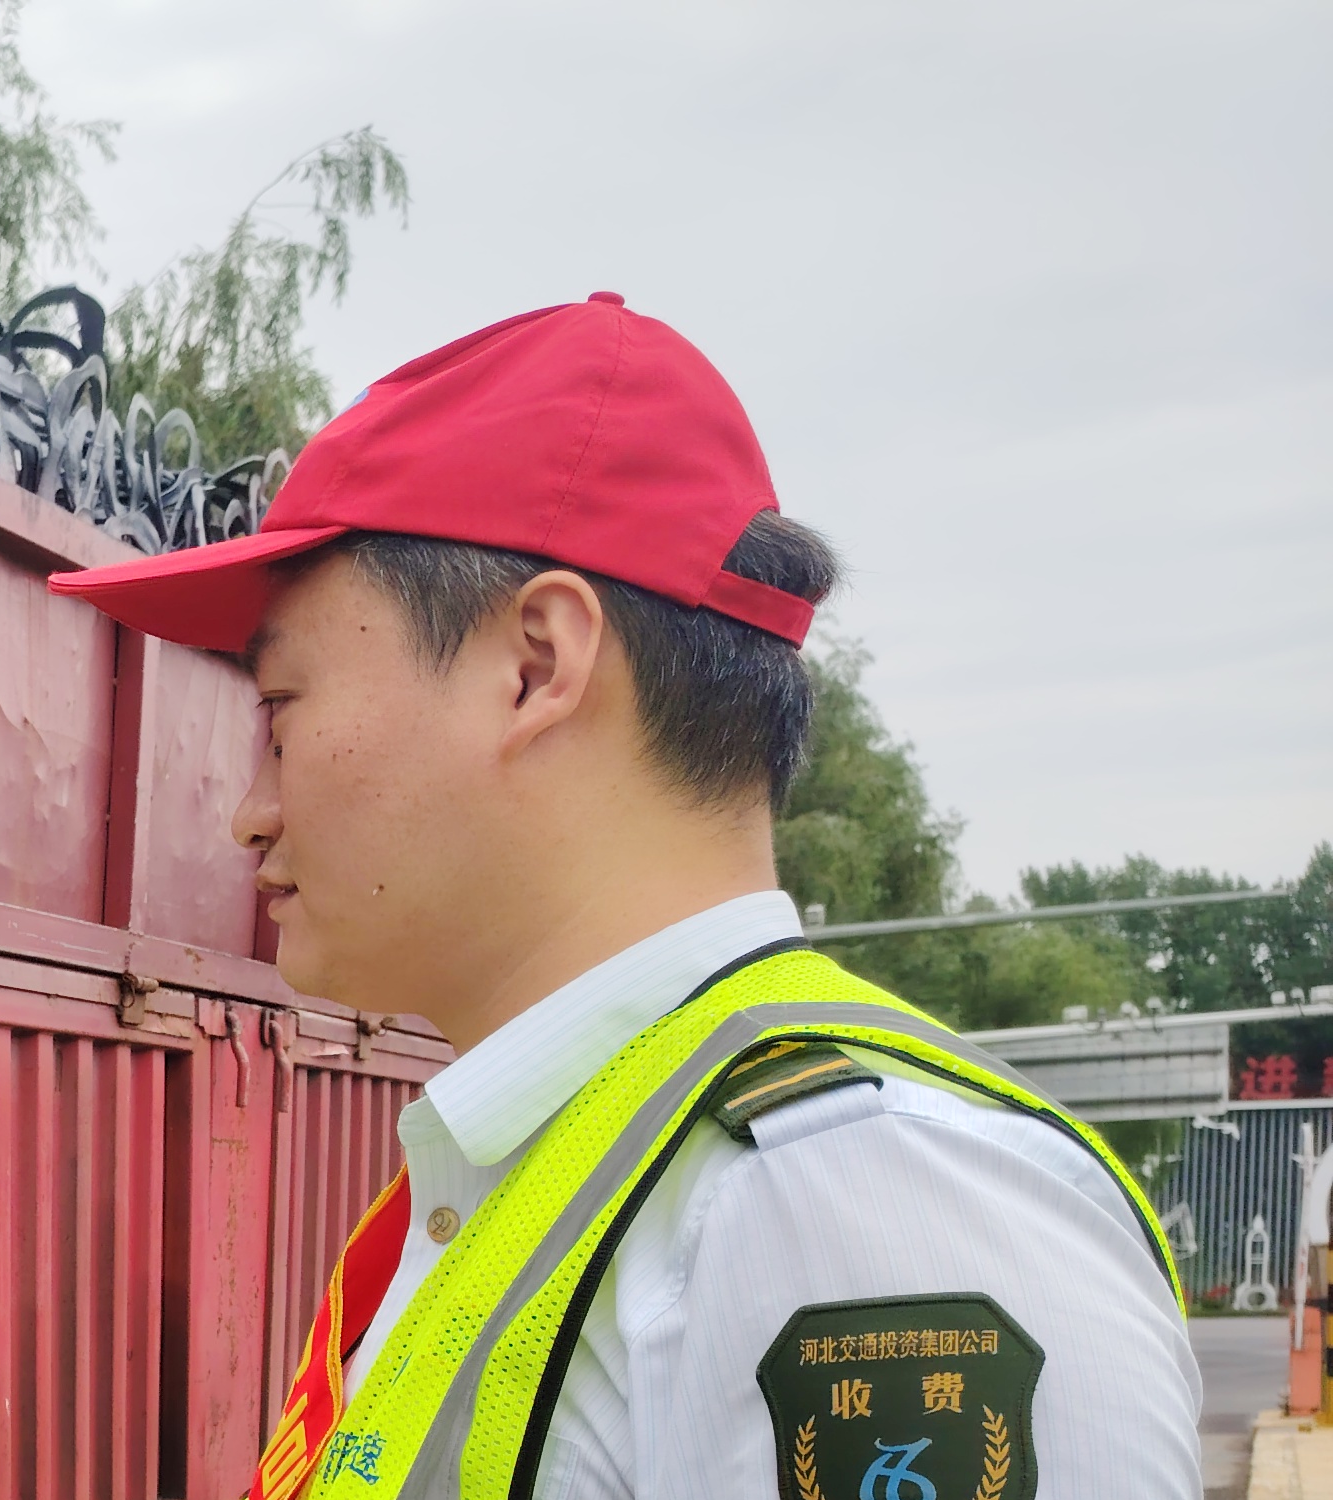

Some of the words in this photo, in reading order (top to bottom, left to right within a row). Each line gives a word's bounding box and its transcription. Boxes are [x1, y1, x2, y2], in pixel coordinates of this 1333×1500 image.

[1239, 1053, 1333, 1101] 进
[799, 1329, 999, 1367] 河北交通投资集团公司
[830, 1372, 965, 1420] 收费
